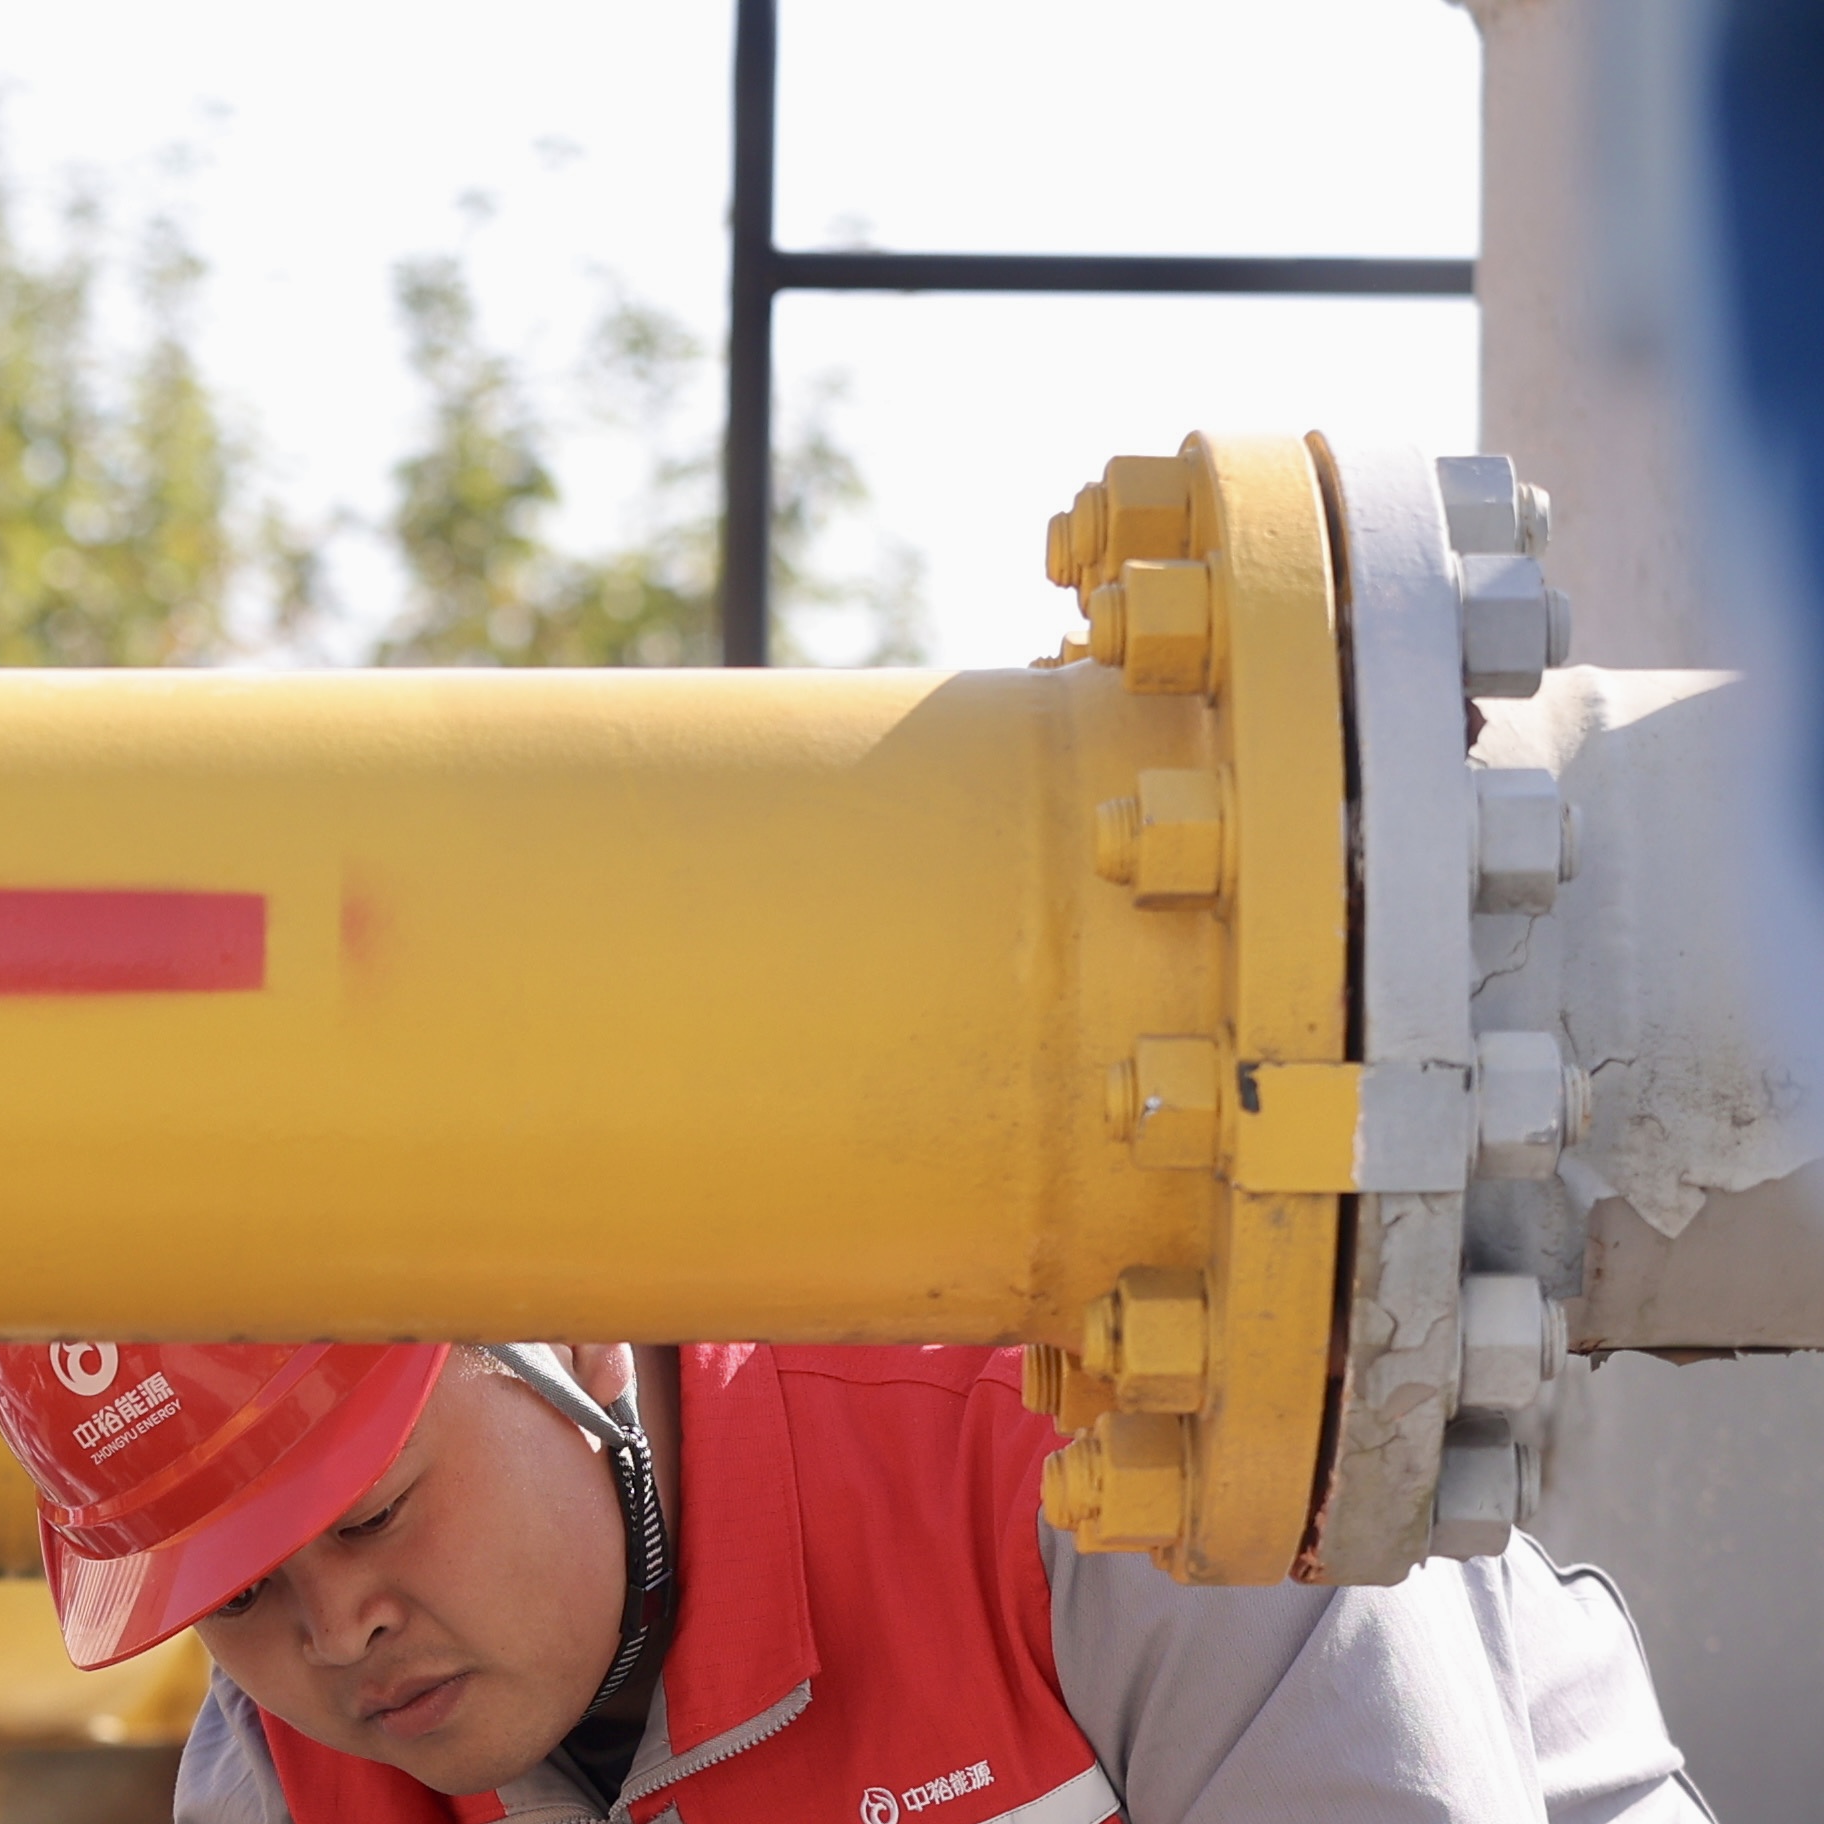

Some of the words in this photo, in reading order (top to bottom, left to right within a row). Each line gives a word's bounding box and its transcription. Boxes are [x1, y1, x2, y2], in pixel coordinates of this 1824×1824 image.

[72, 1371, 175, 1449] 中裕能源
[90, 1428, 138, 1466] ZHONGYU
[135, 1398, 183, 1434] ENERGY
[901, 1759, 995, 1812] 中裕能源
